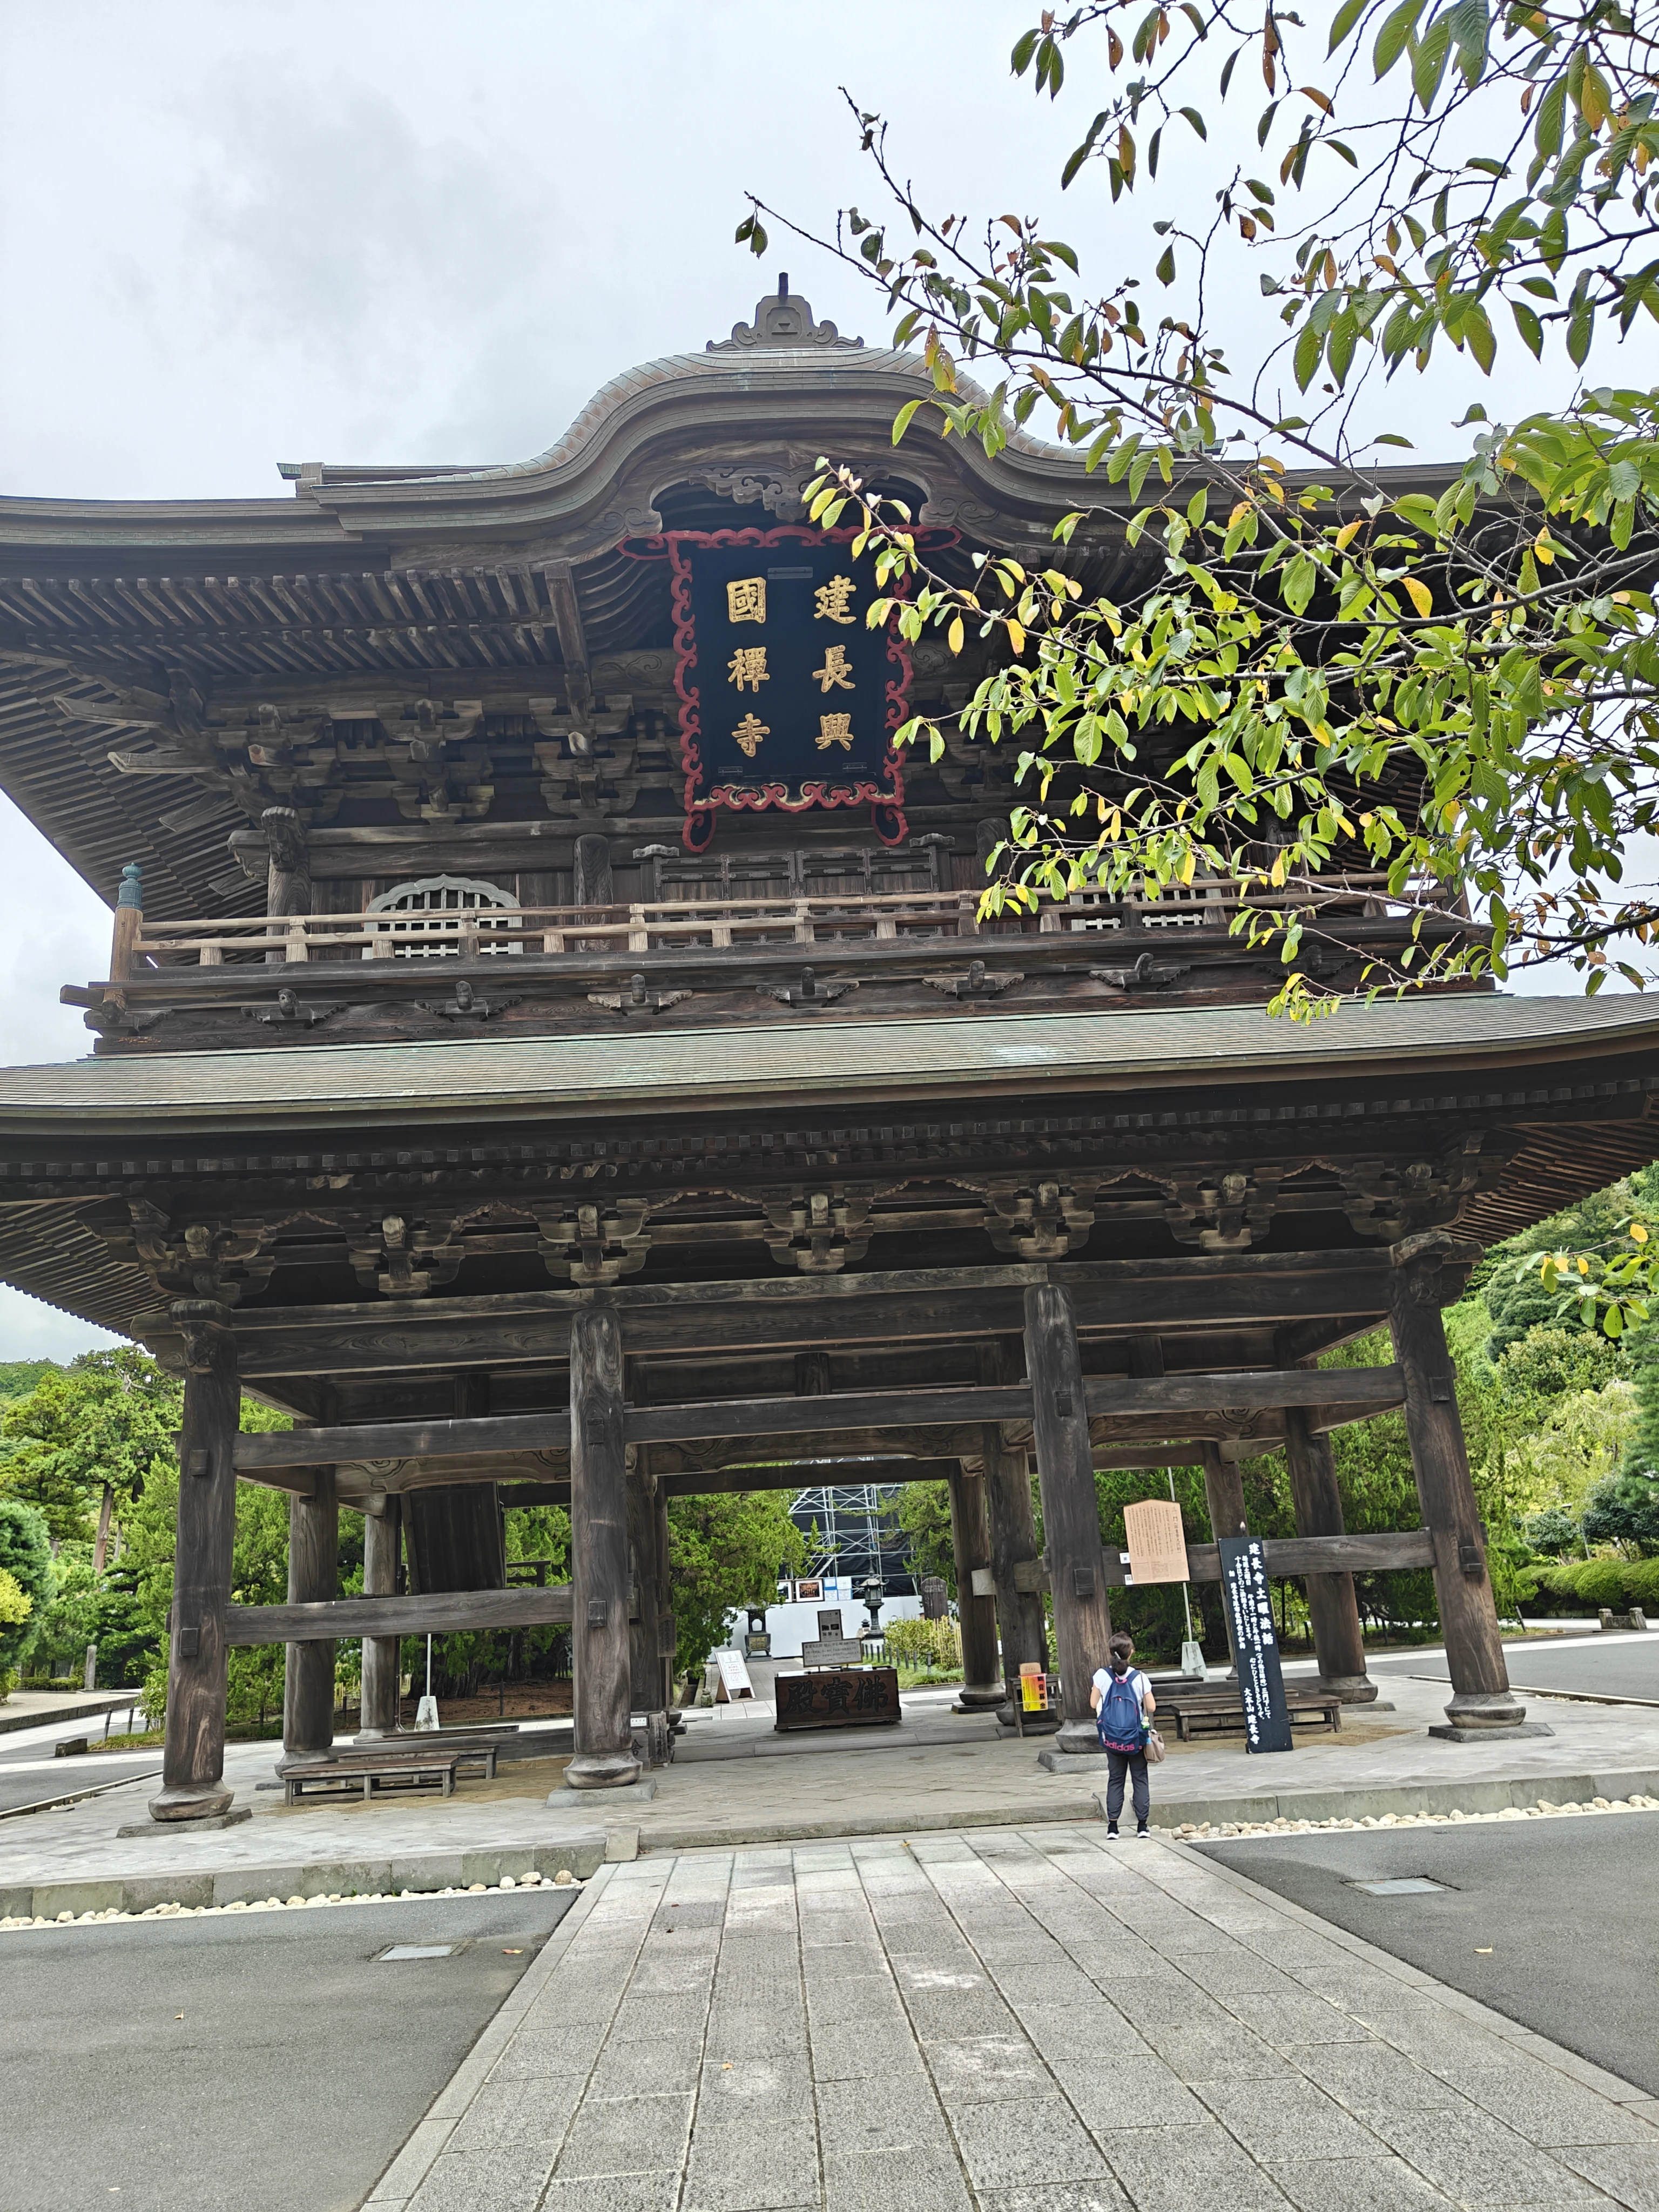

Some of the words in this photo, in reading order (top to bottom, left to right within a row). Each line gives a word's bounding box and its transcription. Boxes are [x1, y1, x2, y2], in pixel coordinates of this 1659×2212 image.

[726, 576, 770, 757] 國禪寺
[812, 575, 857, 751] 建長興
[1249, 1542, 1273, 1645] 建長寺土曜法話
[1103, 1739, 1135, 1751] adidas
